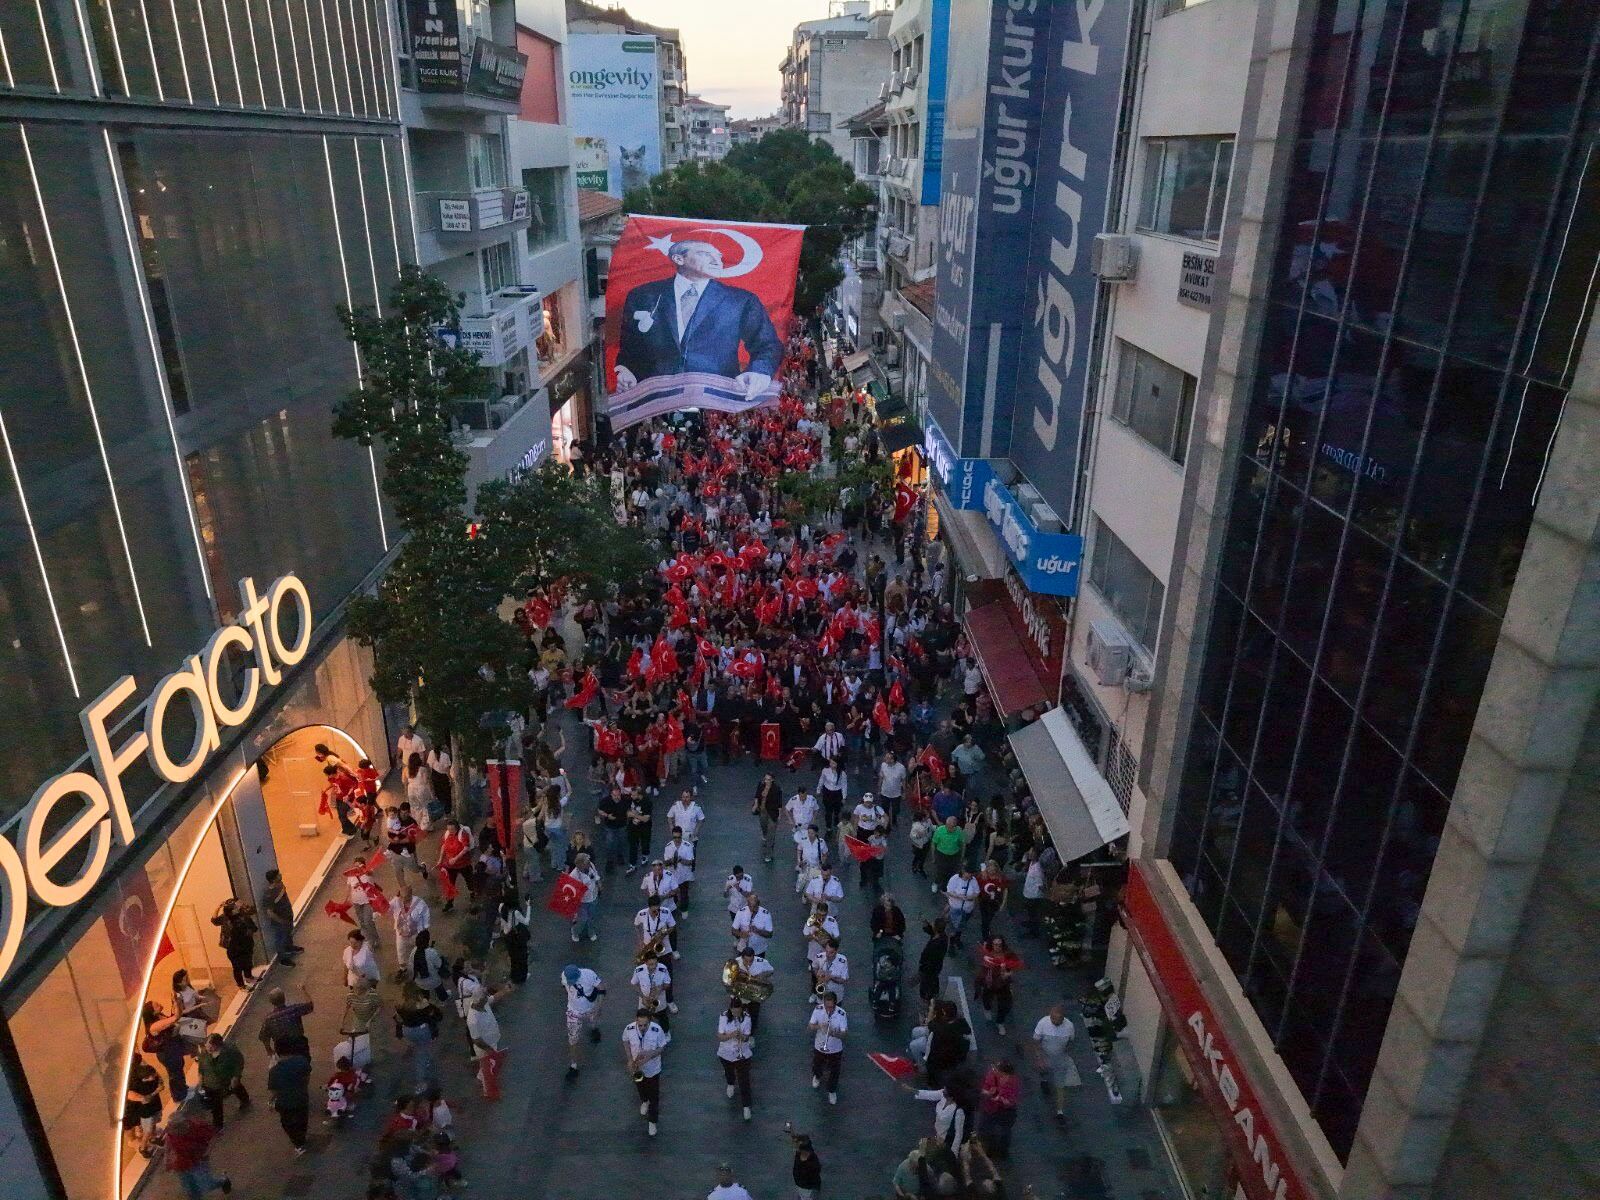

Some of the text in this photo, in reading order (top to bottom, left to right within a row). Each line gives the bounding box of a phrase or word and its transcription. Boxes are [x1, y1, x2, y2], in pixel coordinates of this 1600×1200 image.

[984, 103, 1031, 214] uğur
[1033, 92, 1087, 451] uğur
[1184, 273, 1209, 288] AVUKAT
[961, 460, 974, 510] uğur
[1037, 554, 1077, 574] uğur
